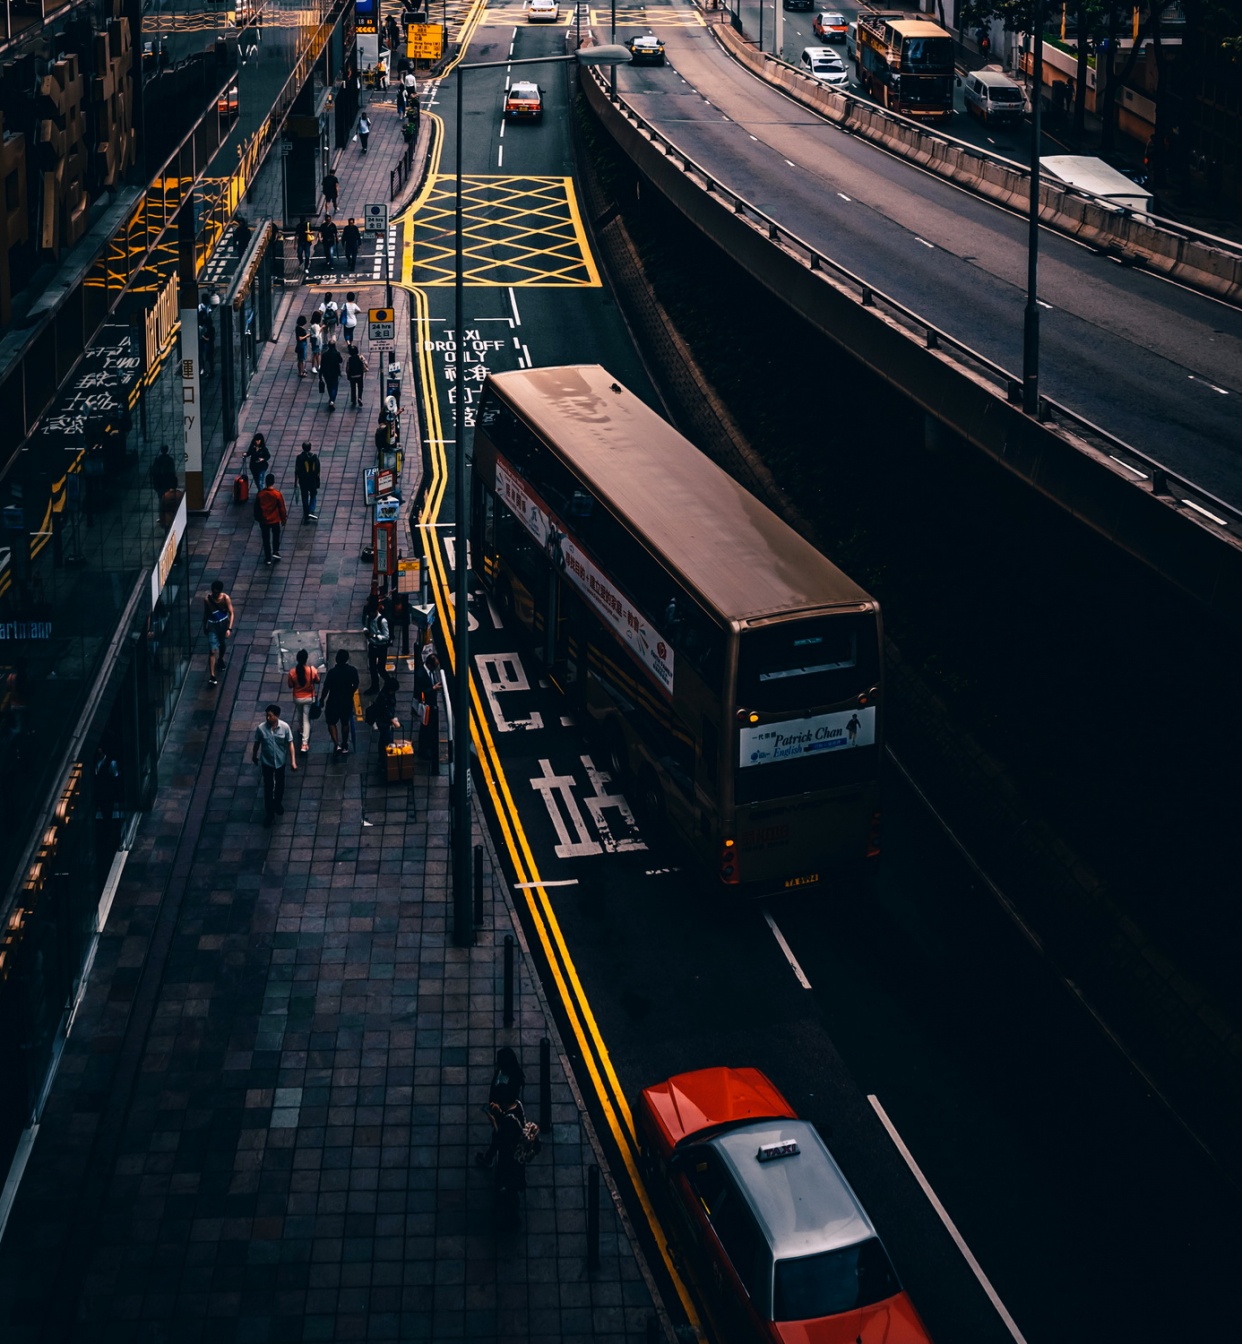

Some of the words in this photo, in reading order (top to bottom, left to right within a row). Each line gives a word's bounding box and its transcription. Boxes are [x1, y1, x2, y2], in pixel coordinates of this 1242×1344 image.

[443, 330, 480, 340] TXI
[424, 340, 466, 352] DRO
[472, 340, 504, 351] OFF
[774, 730, 812, 747] Patrick
[815, 726, 842, 740] Chan
[773, 746, 802, 758] English
[529, 754, 650, 859] 站
[764, 1144, 797, 1158] TAXI
